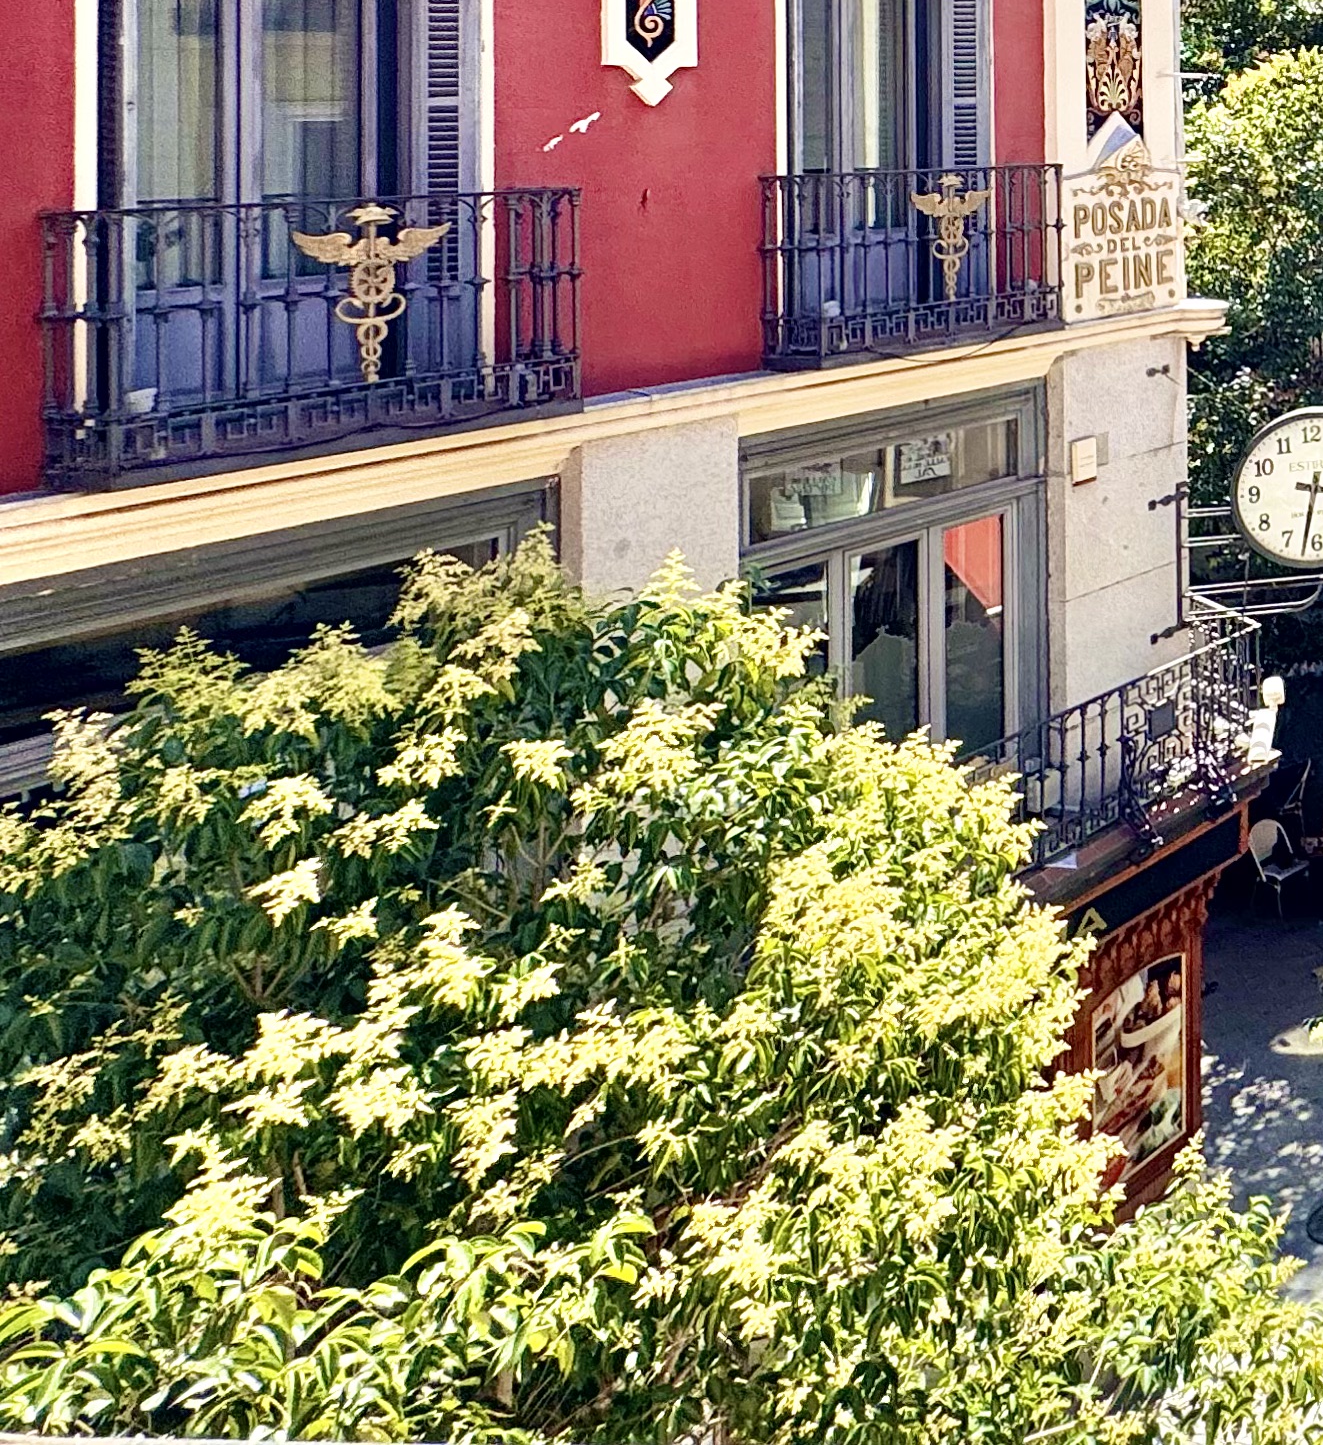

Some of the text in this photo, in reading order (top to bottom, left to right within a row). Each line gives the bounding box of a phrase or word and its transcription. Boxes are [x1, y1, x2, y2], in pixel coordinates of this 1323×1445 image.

[1073, 197, 1172, 238] POSADA
[1106, 236, 1141, 254] DEL
[1074, 249, 1174, 299] PEINE
[1301, 425, 1321, 443] 12
[1276, 437, 1292, 455] 11
[1254, 458, 1274, 477] 10
[1248, 485, 1260, 503] 9
[1258, 513, 1271, 531] 8
[1282, 529, 1294, 548] 7
[1311, 534, 1323, 551] 6
